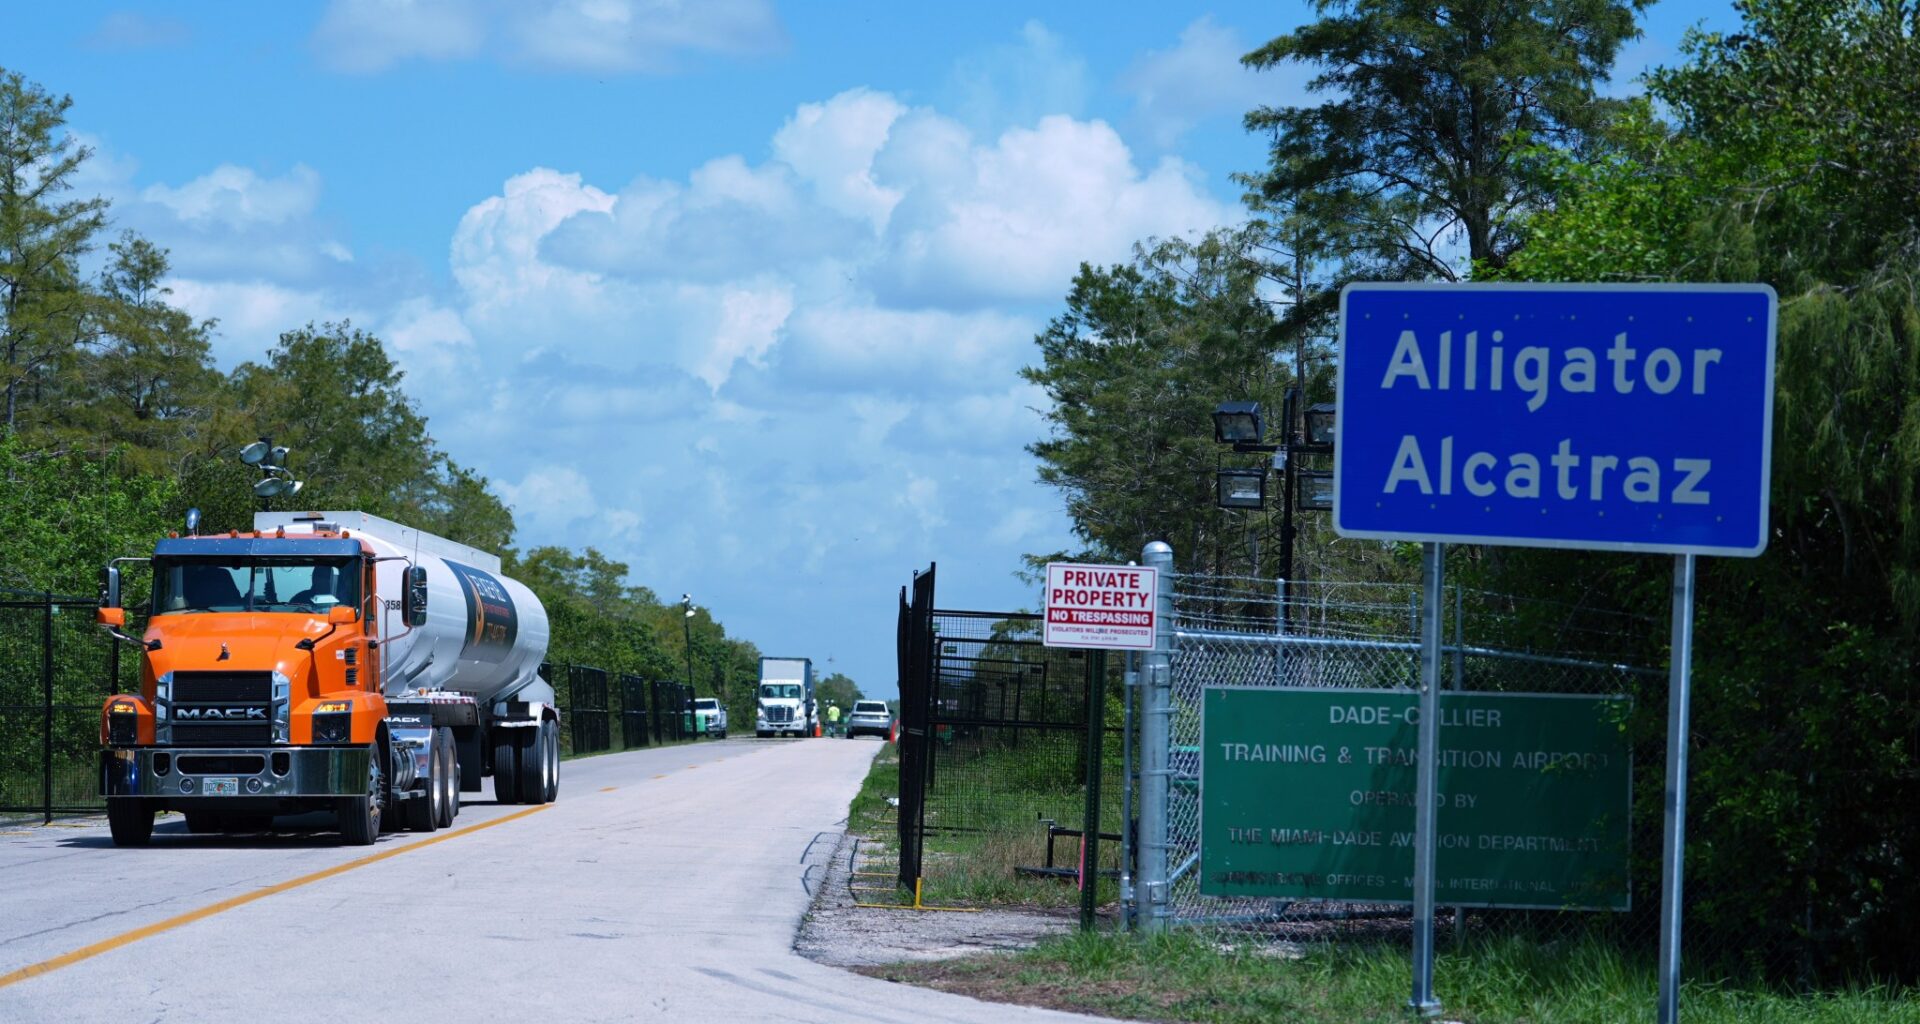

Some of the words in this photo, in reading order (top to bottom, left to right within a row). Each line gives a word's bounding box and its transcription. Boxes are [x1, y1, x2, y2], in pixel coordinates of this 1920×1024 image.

[1380, 330, 1722, 413] Alligator
[1383, 435, 1712, 504] Alcatraz
[1063, 570, 1140, 589] PRIVATE
[1052, 589, 1150, 608] PROPERTY
[1051, 610, 1069, 621] NO
[1071, 611, 1149, 625] TRESPASSING
[1052, 626, 1084, 634] VIOLATORS
[1110, 628, 1149, 636] PROSECUTED
[176, 707, 267, 719] MACK
[1329, 705, 1501, 728] DADE-CLLIER
[1221, 743, 1326, 764] TRAINING
[1337, 746, 1352, 764] &
[1364, 746, 1502, 769] TRANITION
[1455, 793, 1478, 809] BY
[1229, 827, 1262, 845] THE
[1271, 828, 1382, 847] MIAMI-DADE
[1326, 873, 1385, 888] OFFICES
